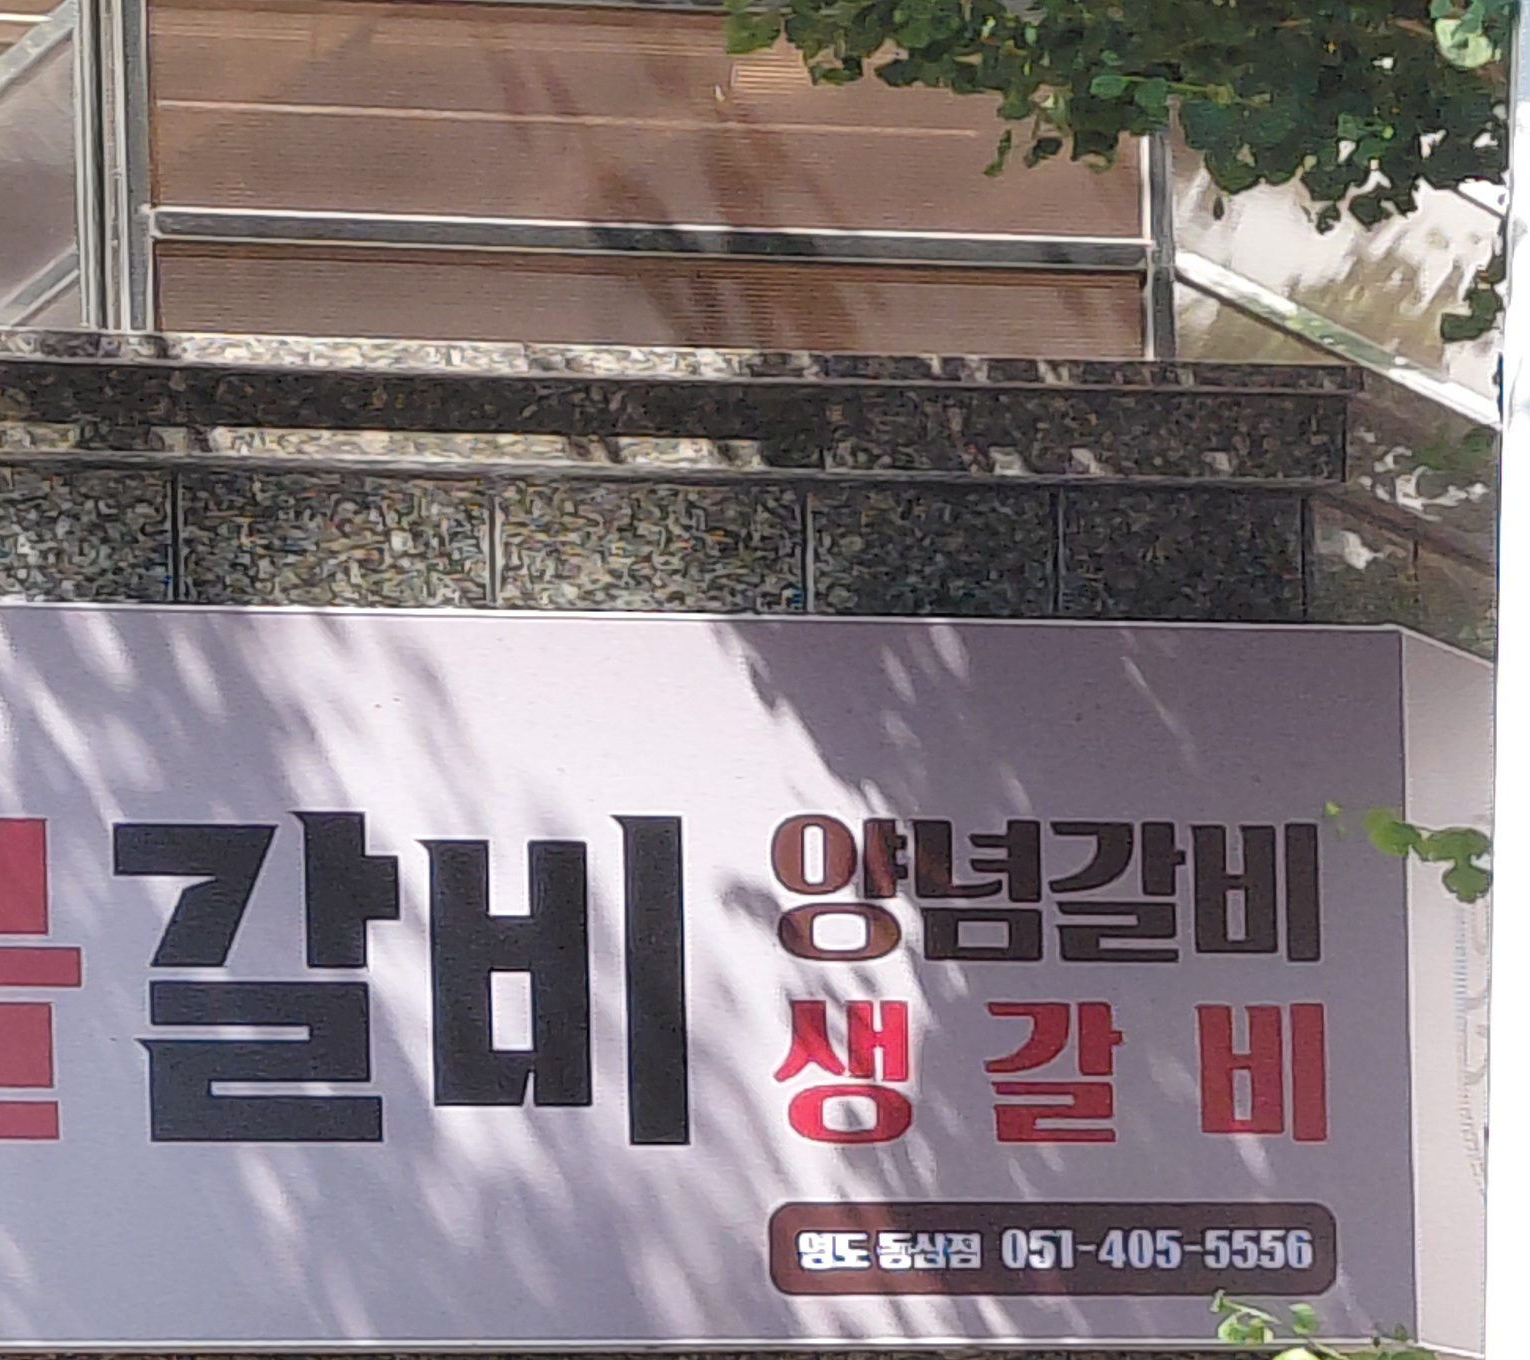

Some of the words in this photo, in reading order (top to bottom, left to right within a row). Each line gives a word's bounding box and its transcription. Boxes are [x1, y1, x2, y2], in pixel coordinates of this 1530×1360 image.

[770, 814, 1323, 962] 양념갈비
[798, 1230, 870, 1270] 영도
[1000, 1227, 1313, 1271] 051-405-5556
